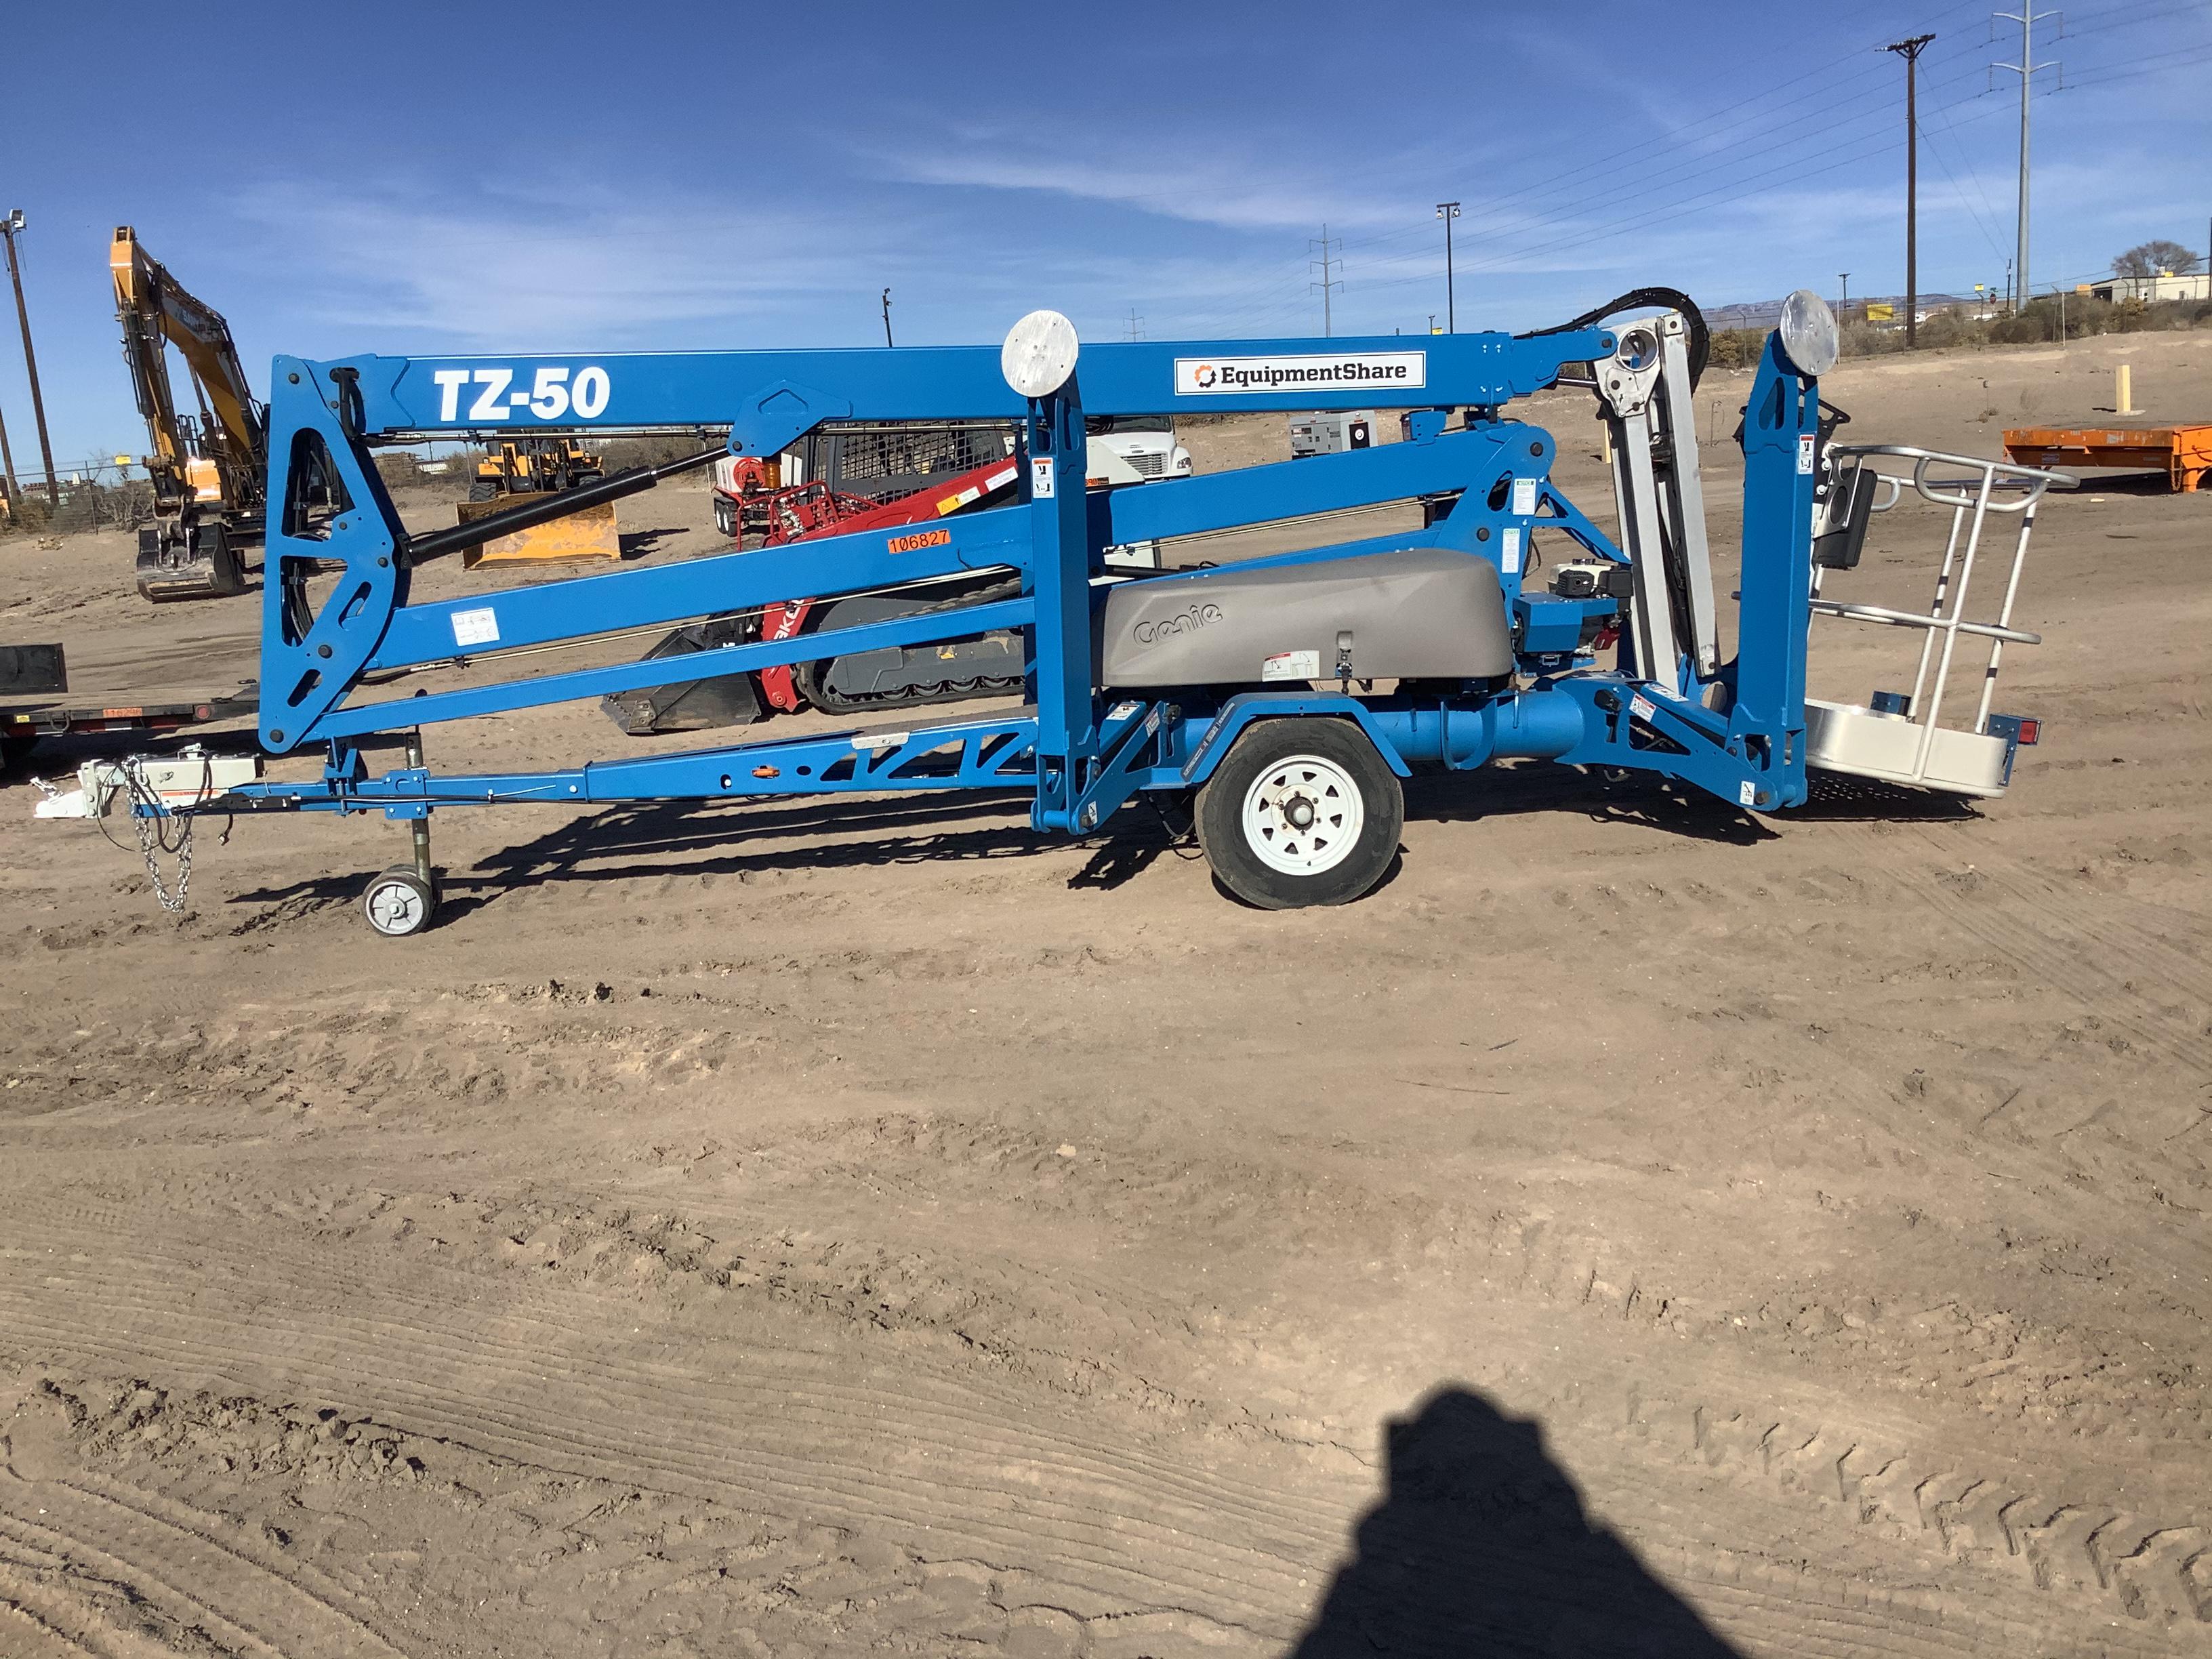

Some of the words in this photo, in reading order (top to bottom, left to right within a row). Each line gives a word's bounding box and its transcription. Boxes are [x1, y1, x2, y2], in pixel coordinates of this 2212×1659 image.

[1221, 363, 1406, 387] EquipmentShare
[434, 367, 610, 421] TZ-50
[890, 530, 947, 552] 106827
[1134, 604, 1223, 650] Genie
